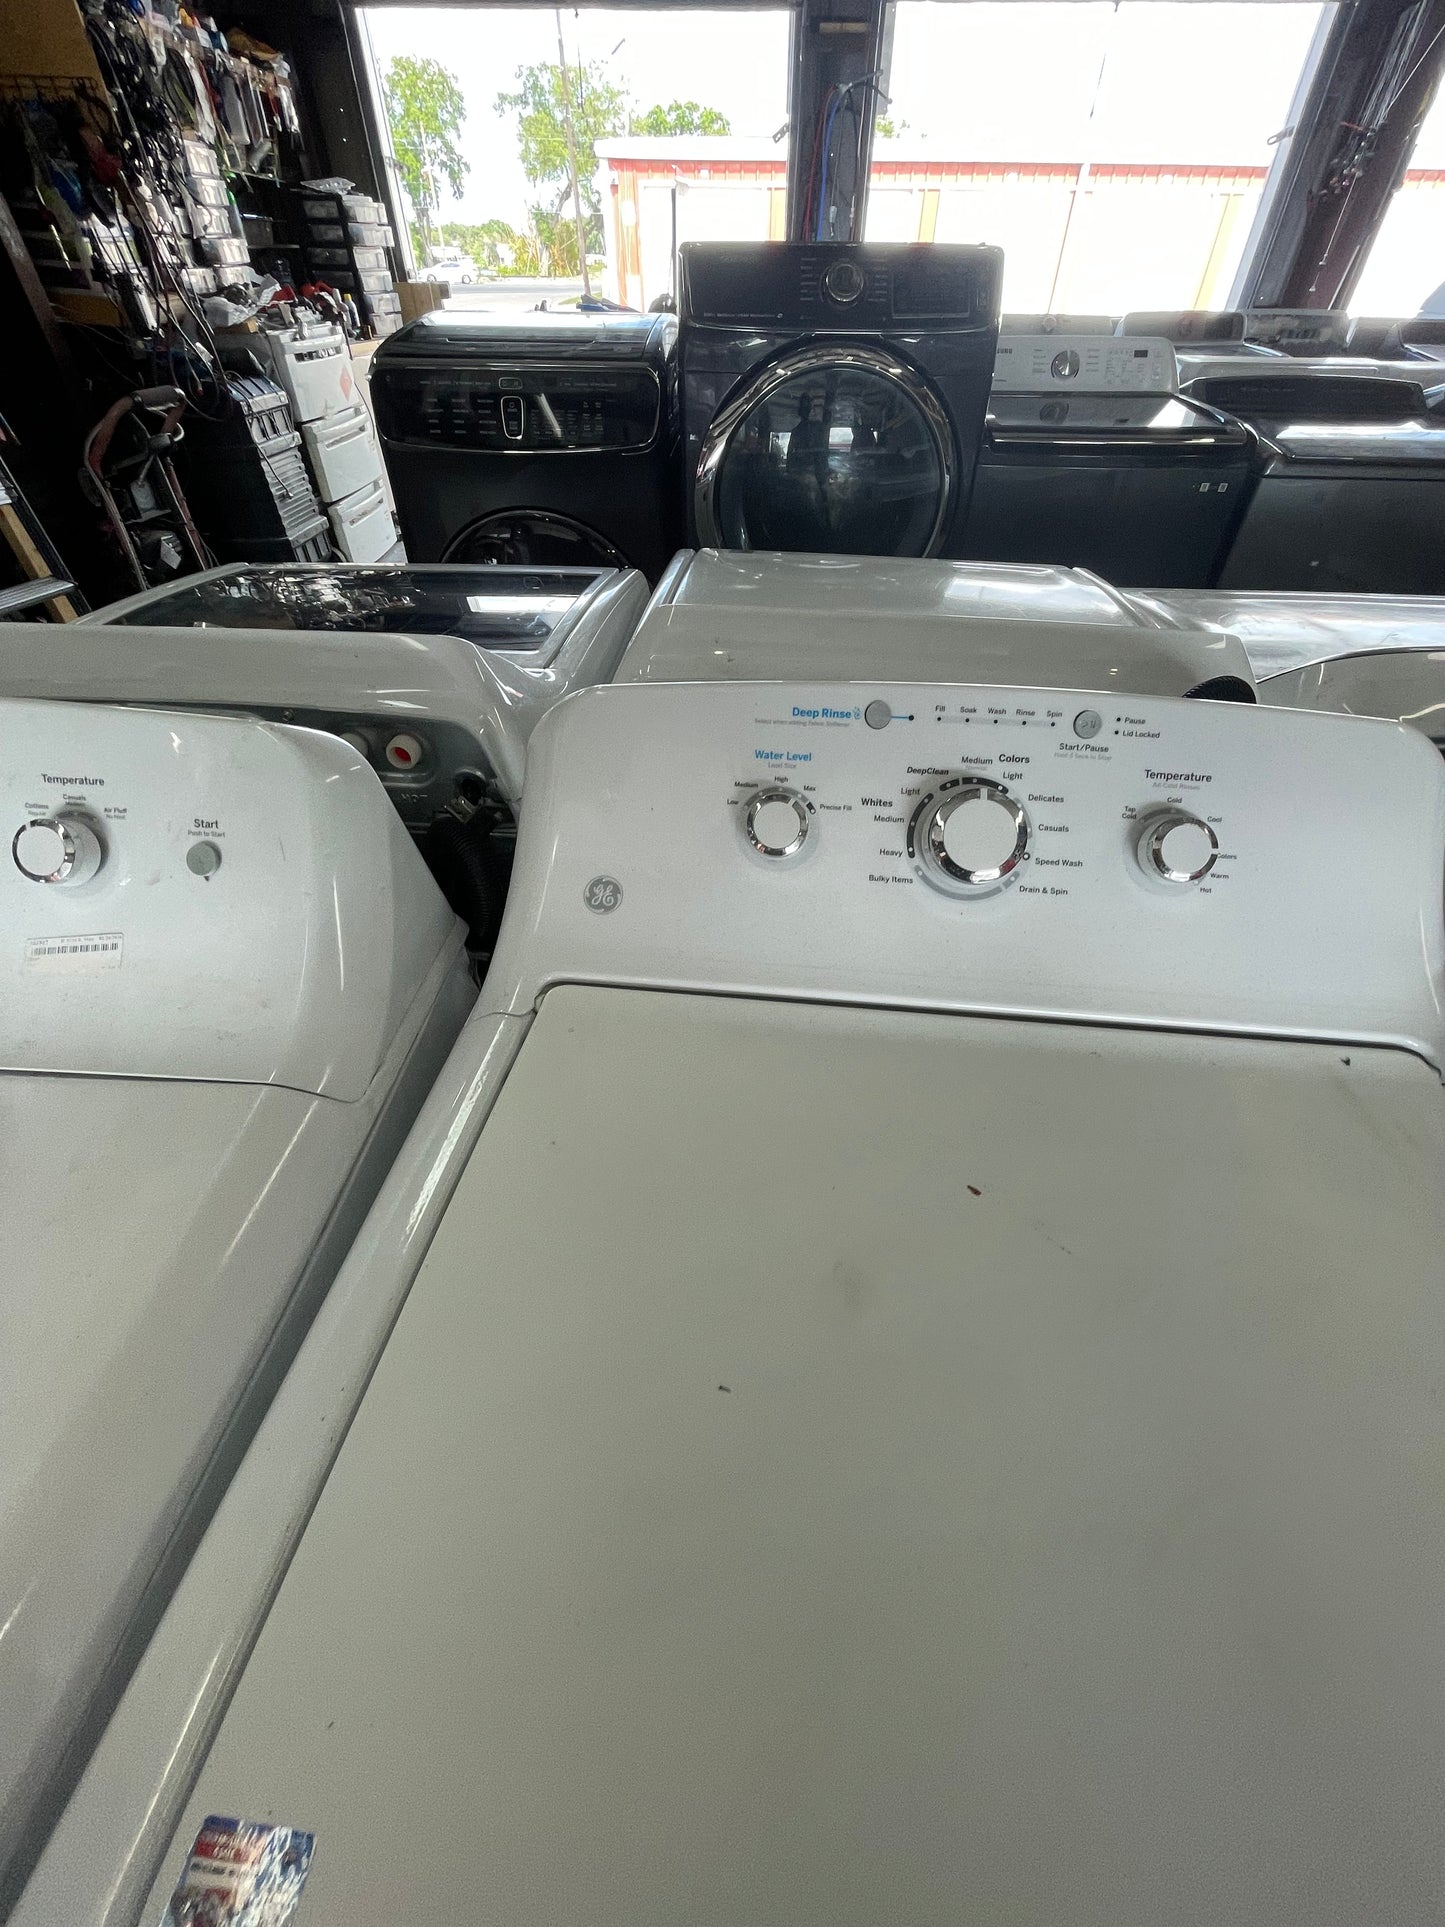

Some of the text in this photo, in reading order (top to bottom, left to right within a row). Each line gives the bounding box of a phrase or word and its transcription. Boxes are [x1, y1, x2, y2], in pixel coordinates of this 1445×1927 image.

[792, 706, 851, 719] Deep Rinse
[987, 707, 1007, 715] Wash
[1016, 709, 1035, 717] Rinse
[1046, 710, 1062, 718] Spin
[1135, 731, 1160, 739] Locked
[1059, 743, 1109, 752] Start/Pause
[755, 749, 812, 761] Water Level
[999, 754, 1030, 763] Colors
[961, 756, 993, 764] Medium
[906, 766, 949, 775] DeepClean
[41, 773, 105, 786] Temperature
[1002, 771, 1023, 780] Light
[1144, 769, 1212, 782] Temperature
[900, 787, 920, 796] Light
[861, 798, 893, 807] Whites
[1028, 794, 1064, 803] Delicates
[820, 803, 841, 811] Precise
[194, 818, 218, 829] Start
[873, 815, 905, 823] Medium
[1038, 824, 1069, 832] Casuals
[879, 849, 903, 857] Heavy
[1035, 857, 1083, 867] Speed Wash
[868, 874, 890, 883] Bulky
[1019, 885, 1040, 893] Drain
[1050, 887, 1068, 895] Spin
